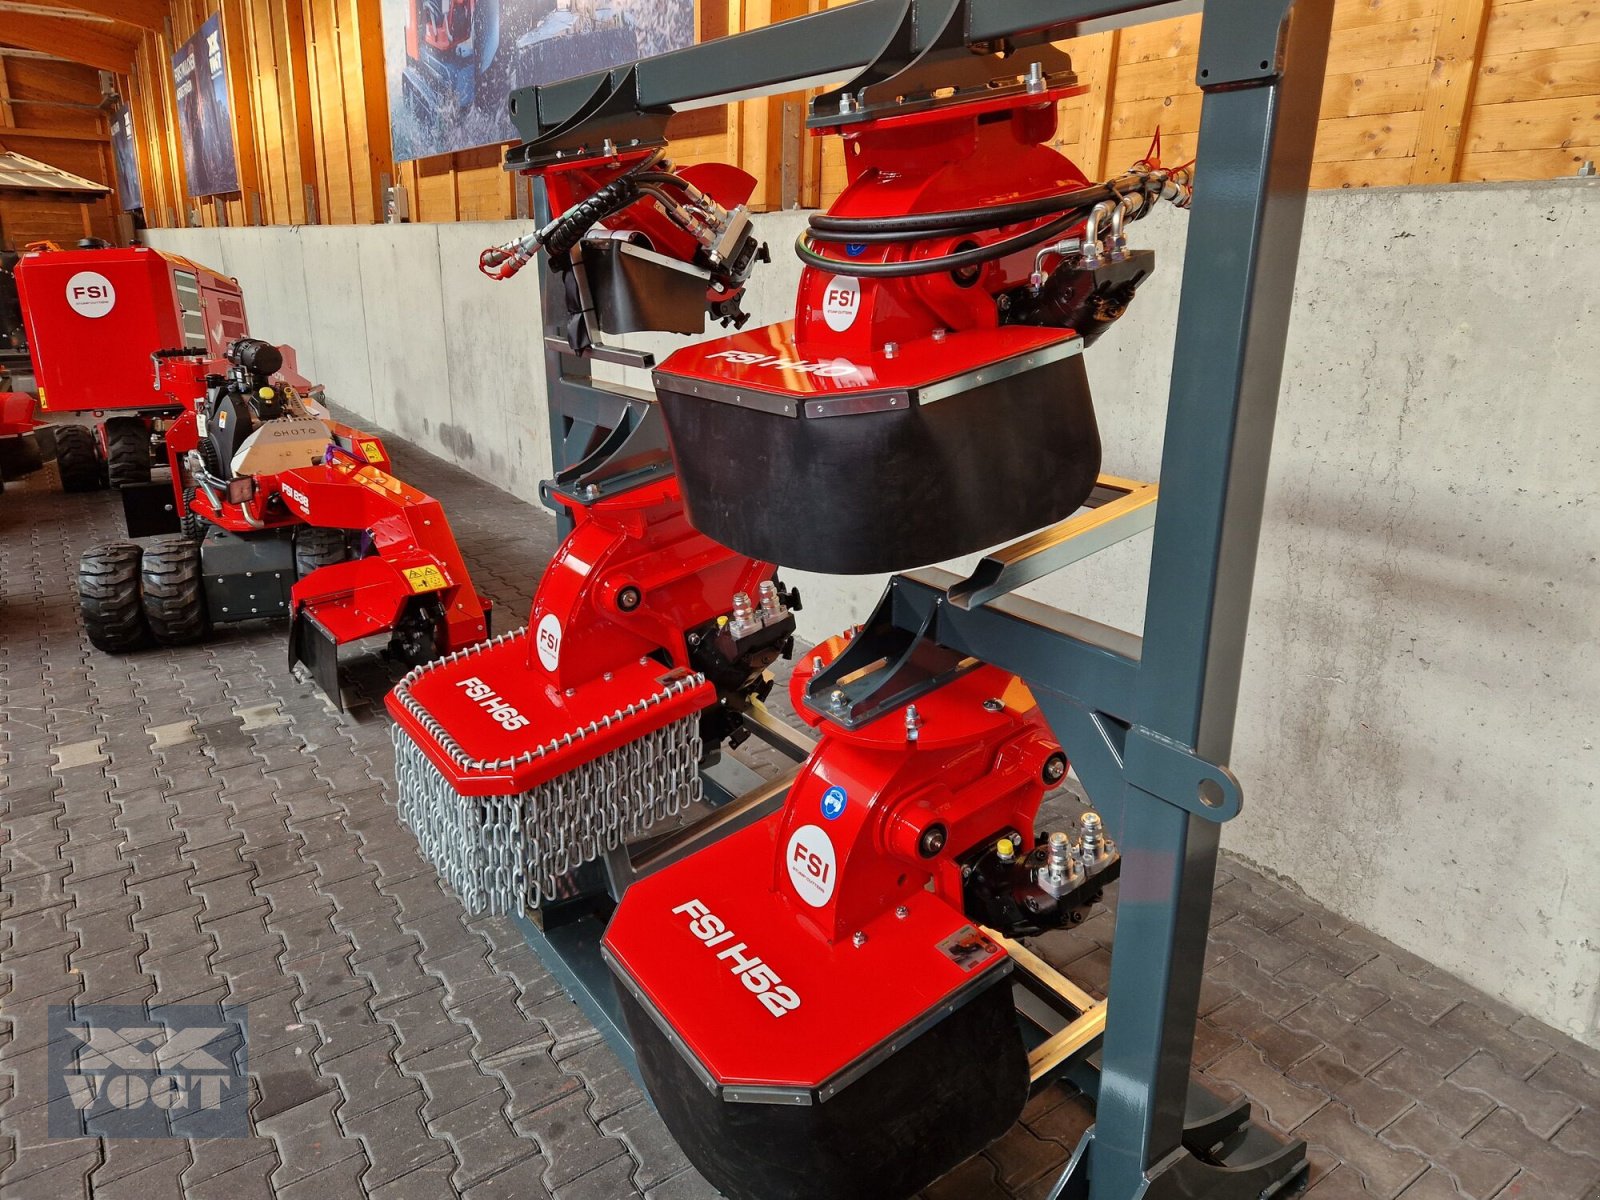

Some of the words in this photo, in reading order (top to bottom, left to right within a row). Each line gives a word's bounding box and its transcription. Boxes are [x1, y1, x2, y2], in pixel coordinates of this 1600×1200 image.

[73, 285, 108, 299] FSI
[828, 290, 855, 307] FSI
[704, 350, 776, 364] FSI
[758, 357, 858, 377] H40
[281, 482, 293, 498] FSI
[540, 628, 559, 652] FSI
[455, 676, 496, 702] FSI
[479, 696, 531, 731] H65
[793, 842, 829, 884] FSI
[671, 898, 735, 948] FSI
[716, 942, 801, 1018] H52
